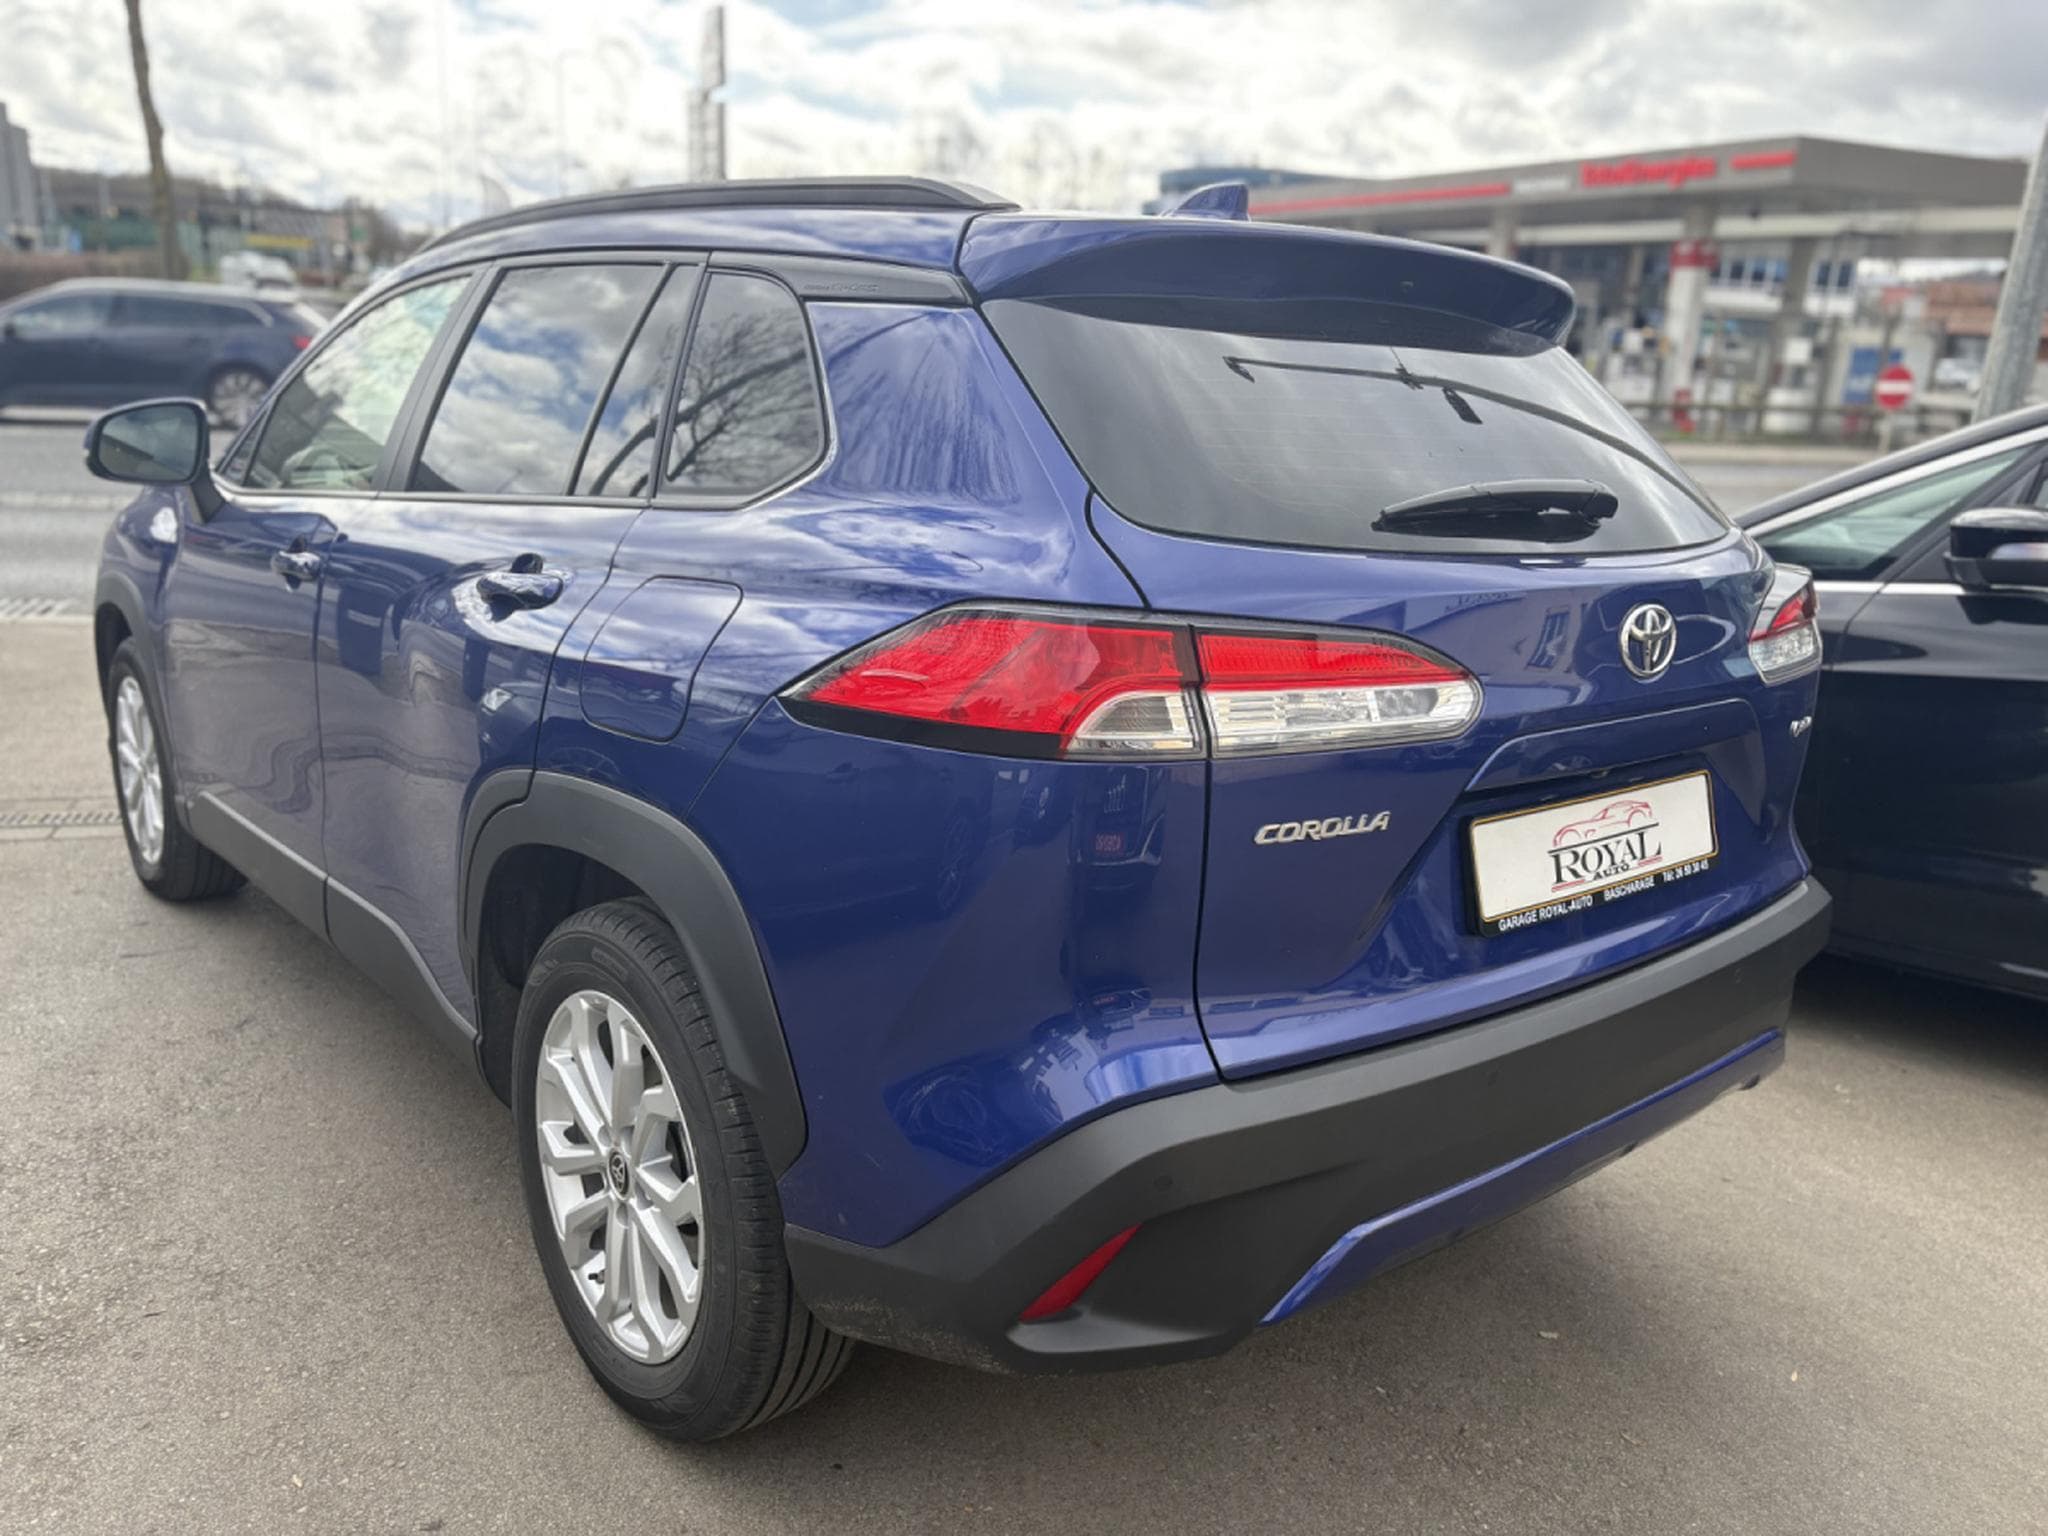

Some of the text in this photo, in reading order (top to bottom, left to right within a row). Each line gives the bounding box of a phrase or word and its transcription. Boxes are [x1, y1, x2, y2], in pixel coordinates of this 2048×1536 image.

[1254, 810, 1391, 844] COROLLA
[1550, 831, 1662, 884] ROYAL
[1498, 910, 1538, 931] GARAGE
[1539, 895, 1593, 920] ROYAL-AUTO
[1604, 875, 1655, 901] BASCHARAGE
